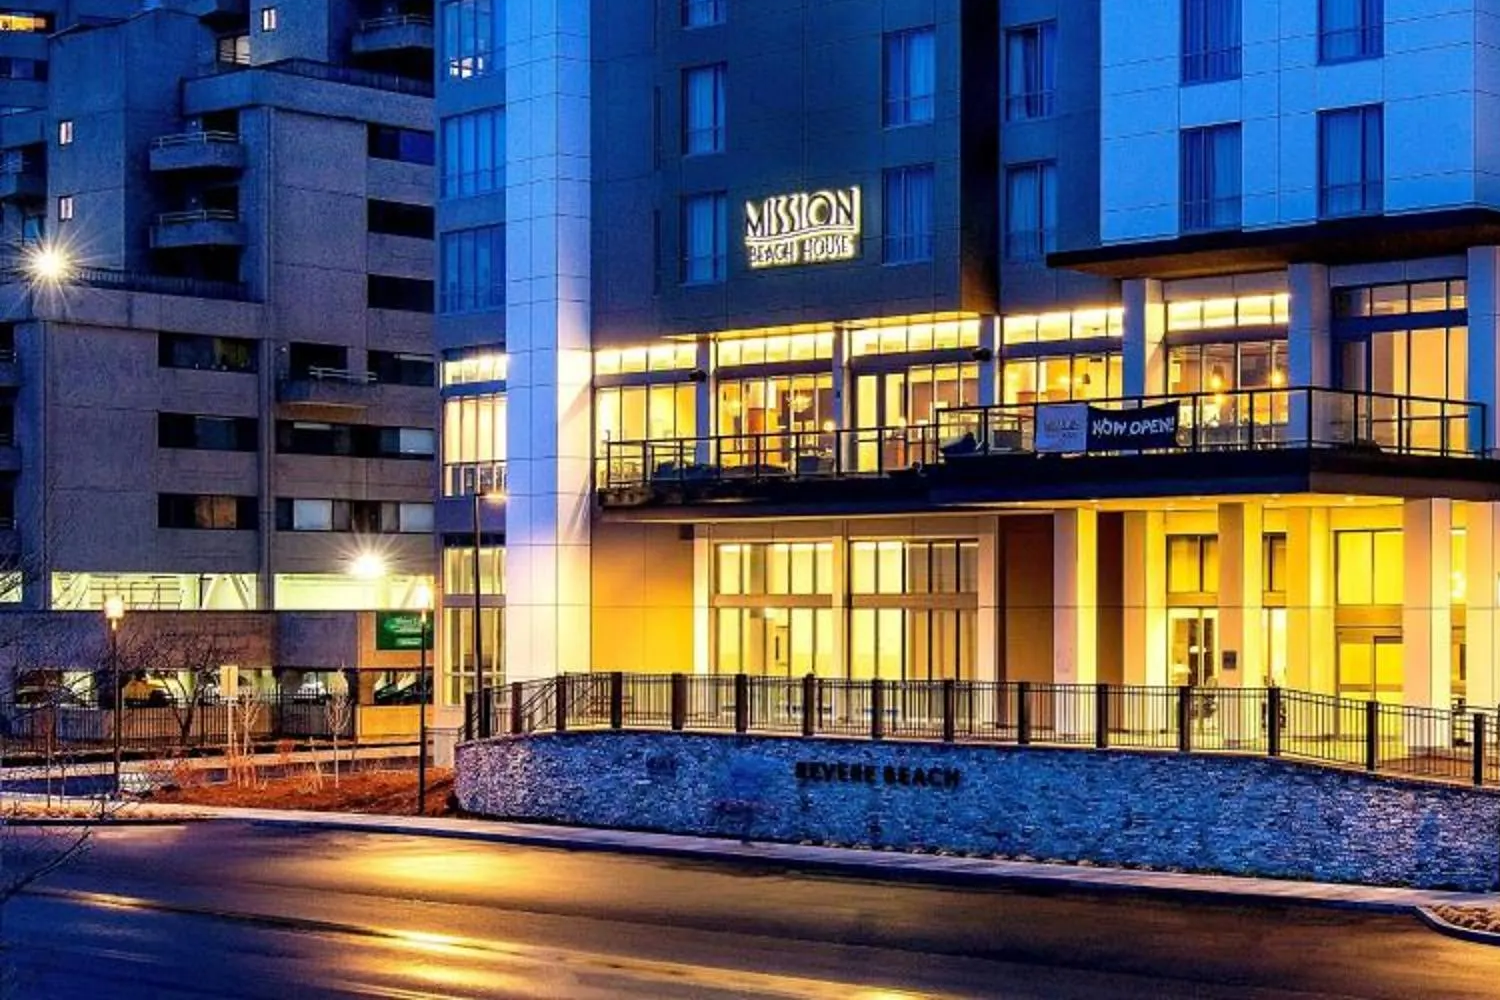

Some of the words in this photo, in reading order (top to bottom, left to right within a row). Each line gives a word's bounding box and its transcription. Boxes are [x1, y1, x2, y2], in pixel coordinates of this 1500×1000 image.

[745, 186, 860, 238] MISSION
[748, 239, 797, 265] BEACH
[803, 234, 853, 260] HOUSE
[1091, 417, 1127, 437] NOW
[1129, 415, 1175, 435] OPEN!
[883, 765, 960, 789] BEACH
